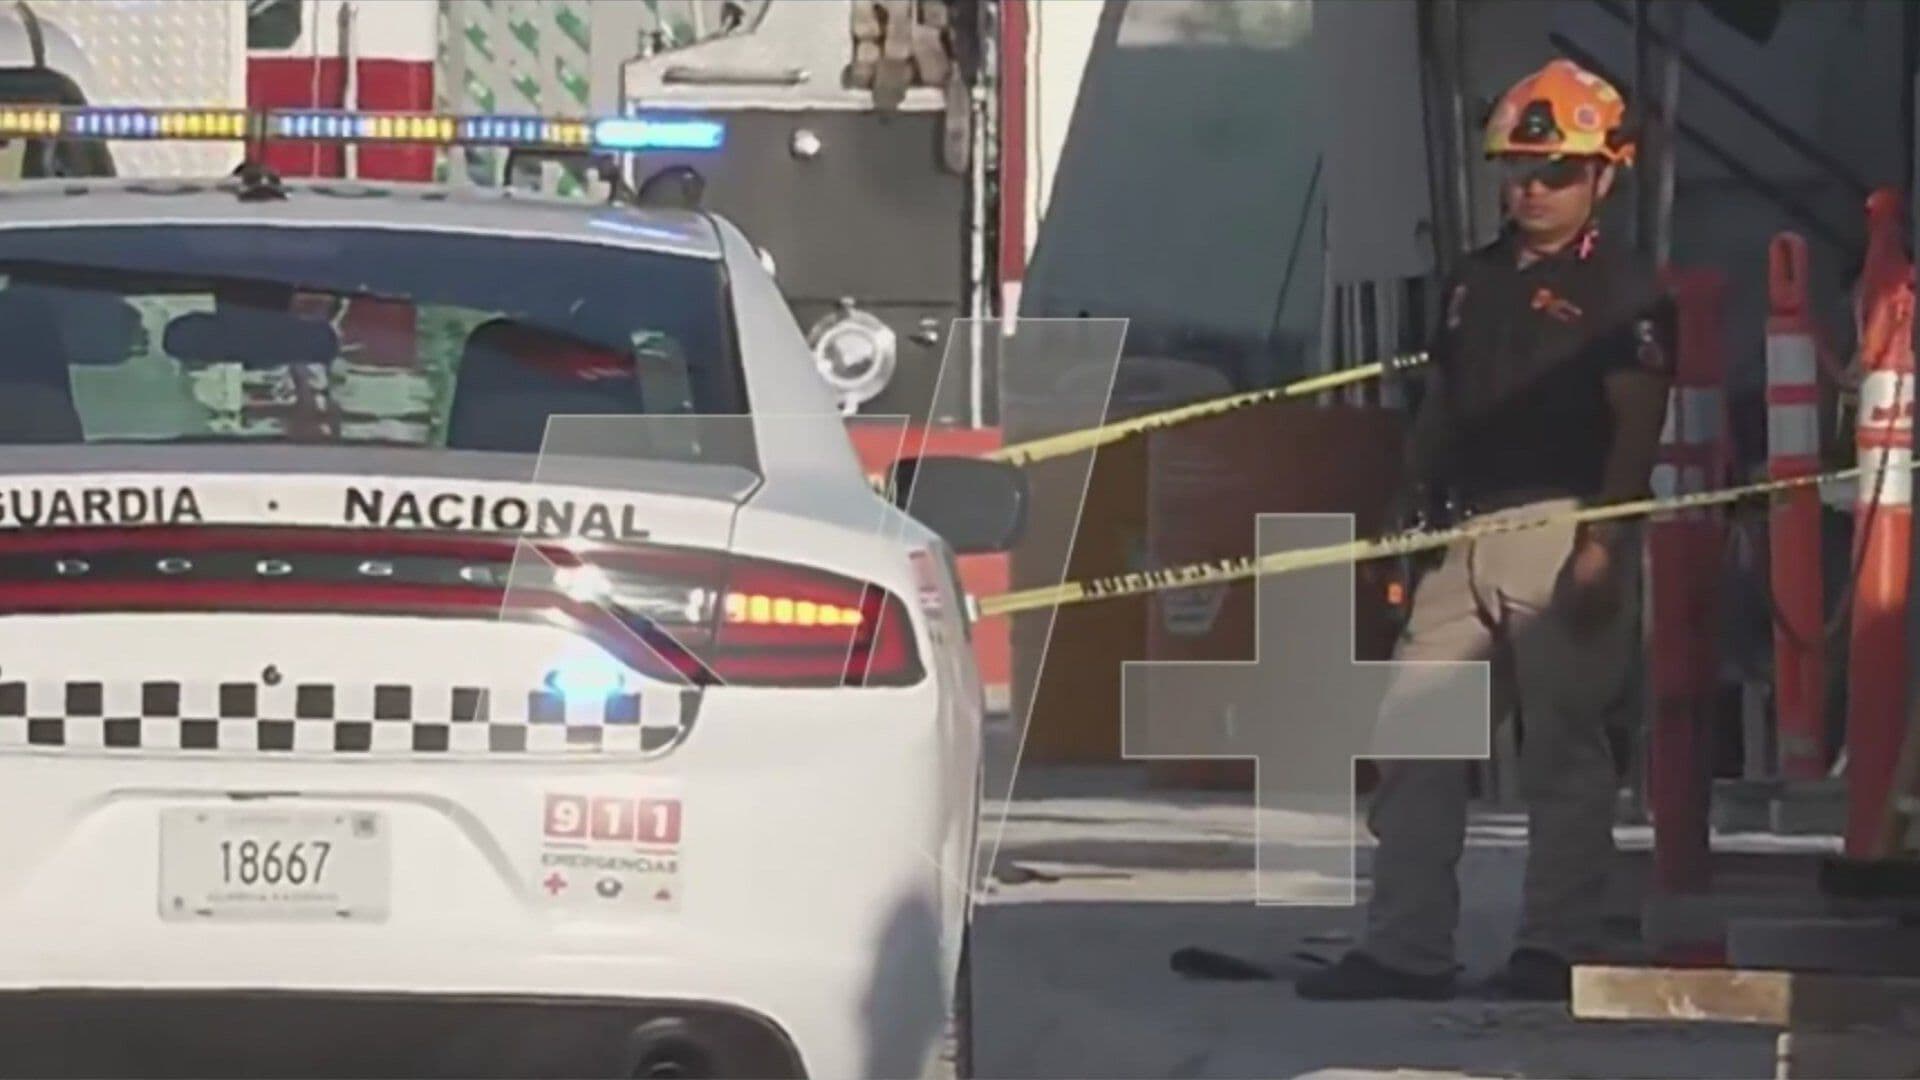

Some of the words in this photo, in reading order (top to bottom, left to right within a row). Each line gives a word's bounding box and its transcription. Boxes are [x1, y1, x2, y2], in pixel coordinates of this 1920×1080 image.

[0, 486, 204, 525] UARDIA
[344, 486, 650, 539] NACIONAL
[552, 799, 670, 839] 911
[220, 839, 332, 885] 18667
